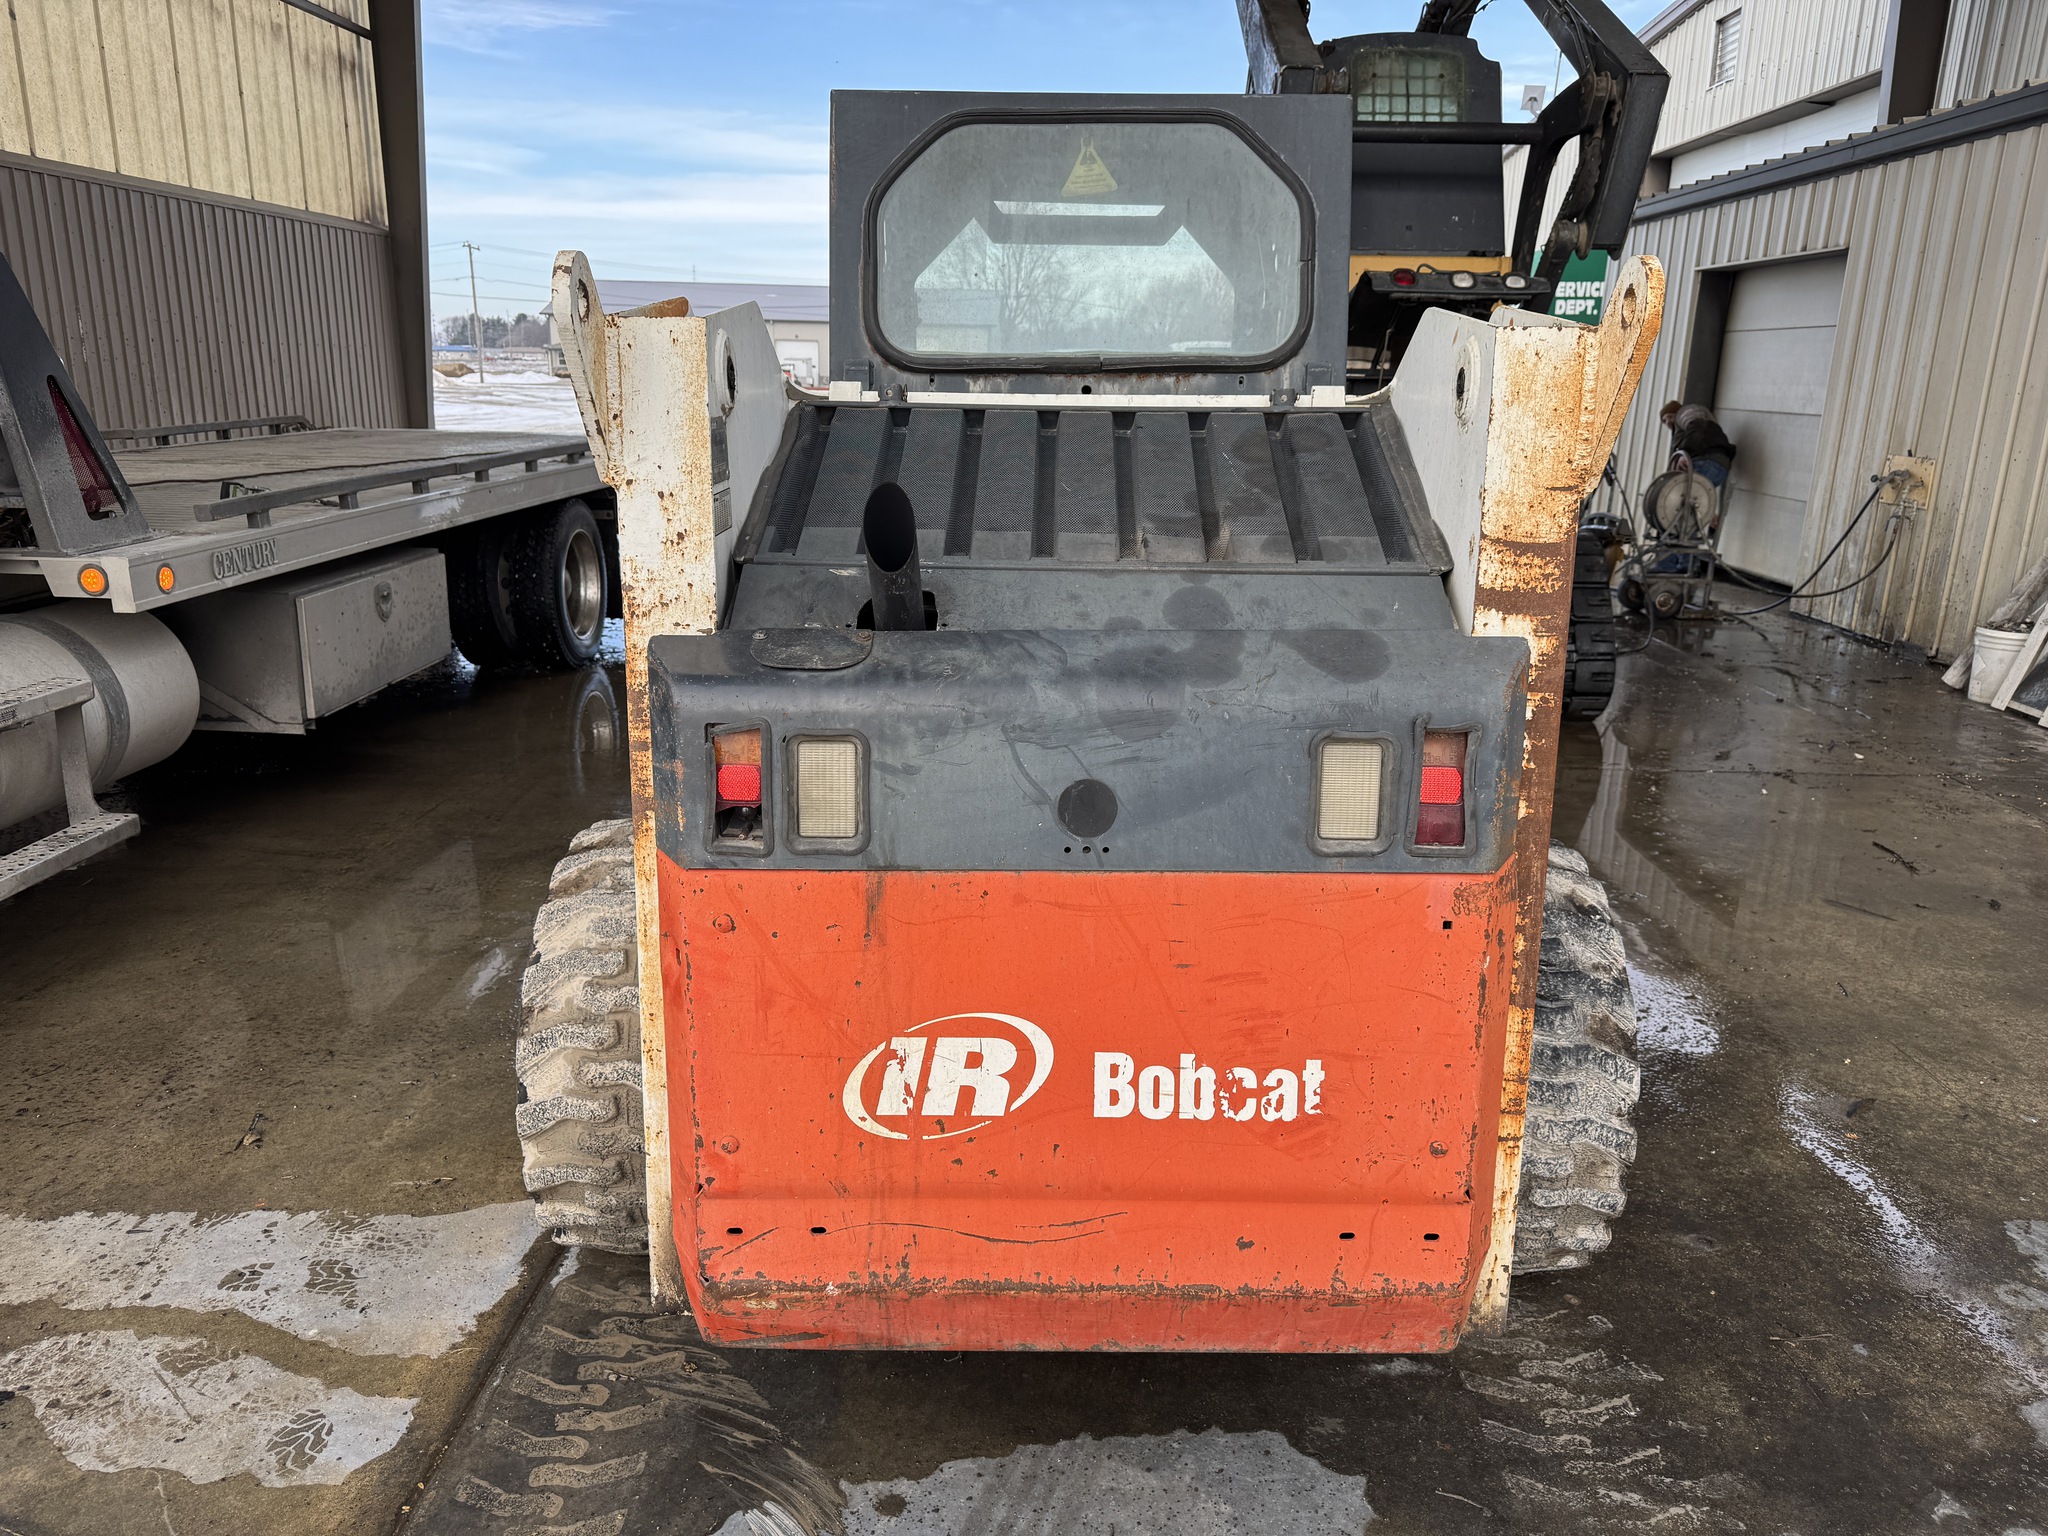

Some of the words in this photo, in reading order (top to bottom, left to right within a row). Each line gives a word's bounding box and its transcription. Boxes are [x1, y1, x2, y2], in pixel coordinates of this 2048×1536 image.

[1555, 281, 1604, 298] ERVIC
[1554, 299, 1598, 316] DEPT.
[212, 537, 278, 580] CENTURY
[876, 1037, 1018, 1117] IR
[1093, 1051, 1325, 1122] Bobcat
